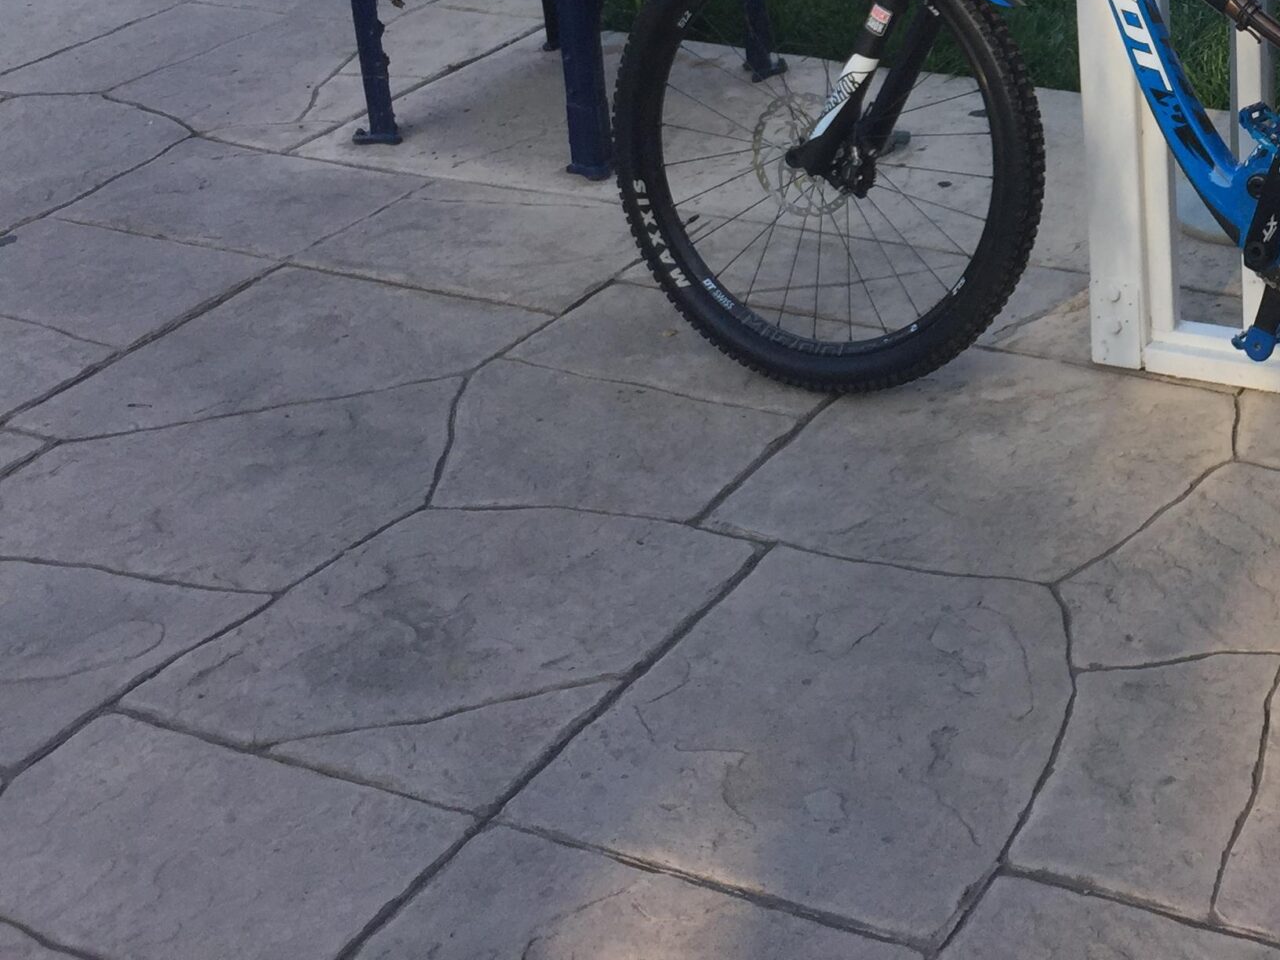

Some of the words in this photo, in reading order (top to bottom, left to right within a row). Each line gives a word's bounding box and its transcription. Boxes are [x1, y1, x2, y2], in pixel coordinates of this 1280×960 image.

[633, 179, 692, 288] MAXXIS
[702, 278, 717, 291] DT
[712, 289, 735, 310] SWISS
